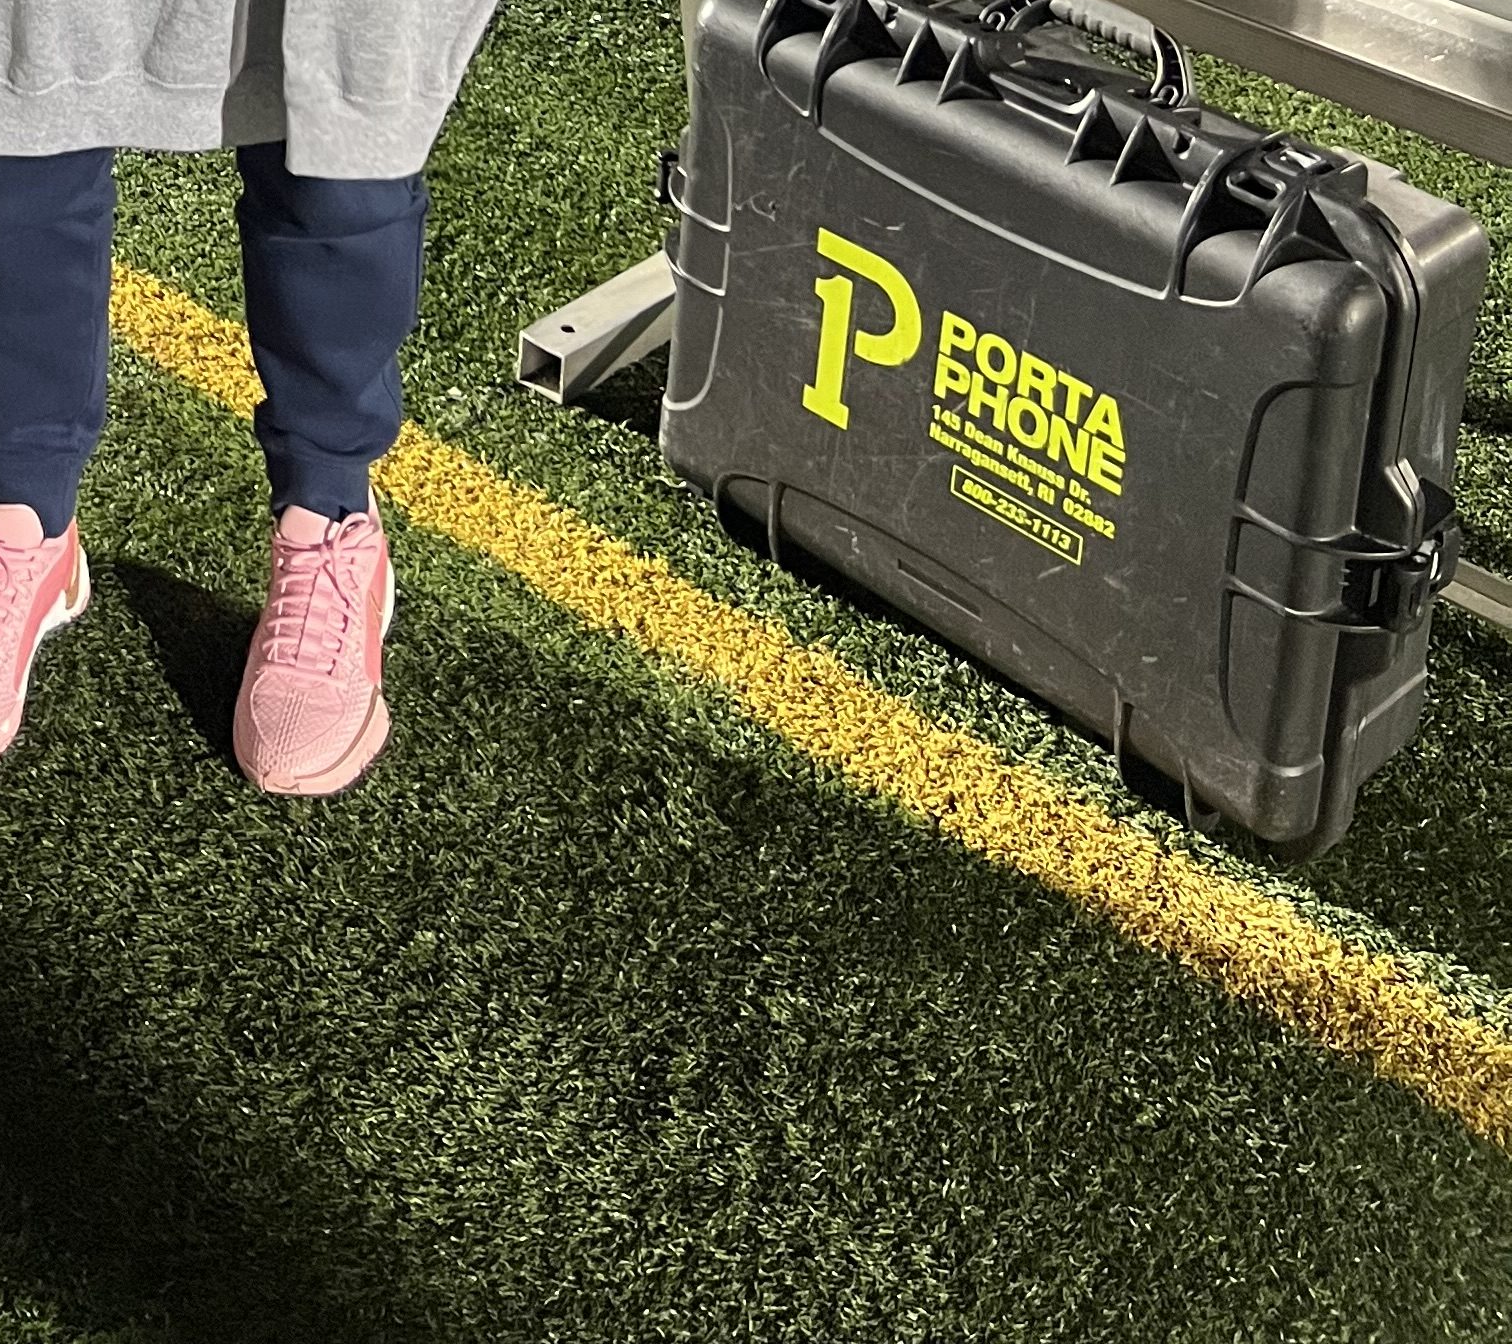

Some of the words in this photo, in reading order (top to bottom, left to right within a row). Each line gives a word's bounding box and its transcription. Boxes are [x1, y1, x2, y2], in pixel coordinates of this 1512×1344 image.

[933, 352, 1126, 496] PHONE
[939, 310, 1125, 450] PORTA
[929, 422, 1034, 496] Narragansett,
[1037, 481, 1055, 505] RI
[1062, 497, 1116, 540] 02882
[932, 404, 961, 432] 145
[964, 420, 1004, 456] Dean
[1007, 444, 1065, 490] Knauss
[1069, 479, 1091, 506] Dr.
[962, 478, 1072, 550] 800-233-1113
